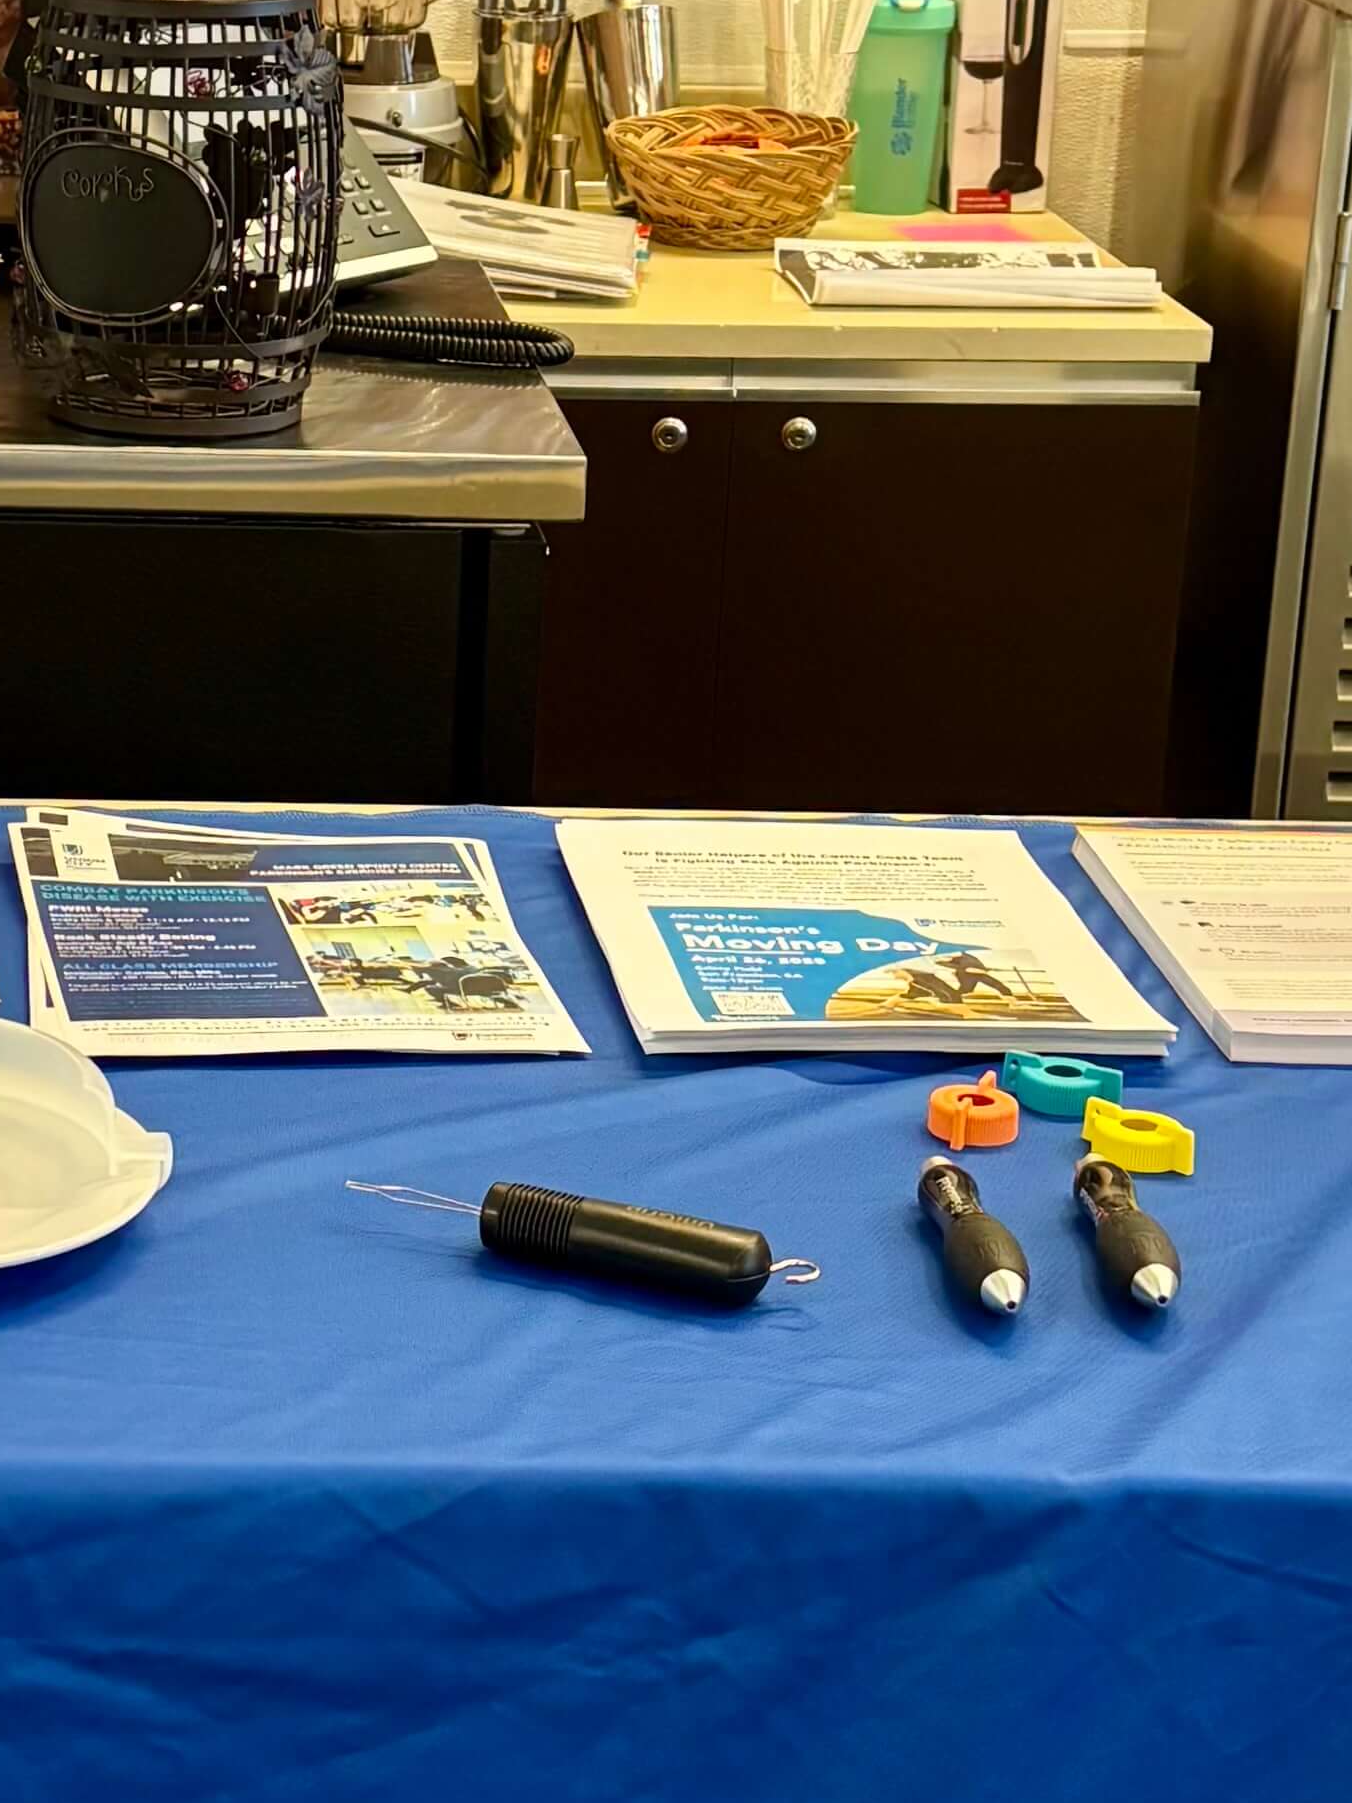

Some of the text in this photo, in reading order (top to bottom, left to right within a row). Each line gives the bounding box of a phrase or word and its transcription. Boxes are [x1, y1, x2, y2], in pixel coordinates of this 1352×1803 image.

[40, 884, 249, 896] COMBAT PARKINSON'S
[41, 892, 267, 903] DISEASE WITH EXERCISE
[674, 922, 821, 935] Parkinson's
[160, 934, 217, 942] Boxing
[681, 933, 940, 956] Moving Day
[690, 954, 737, 965] April
